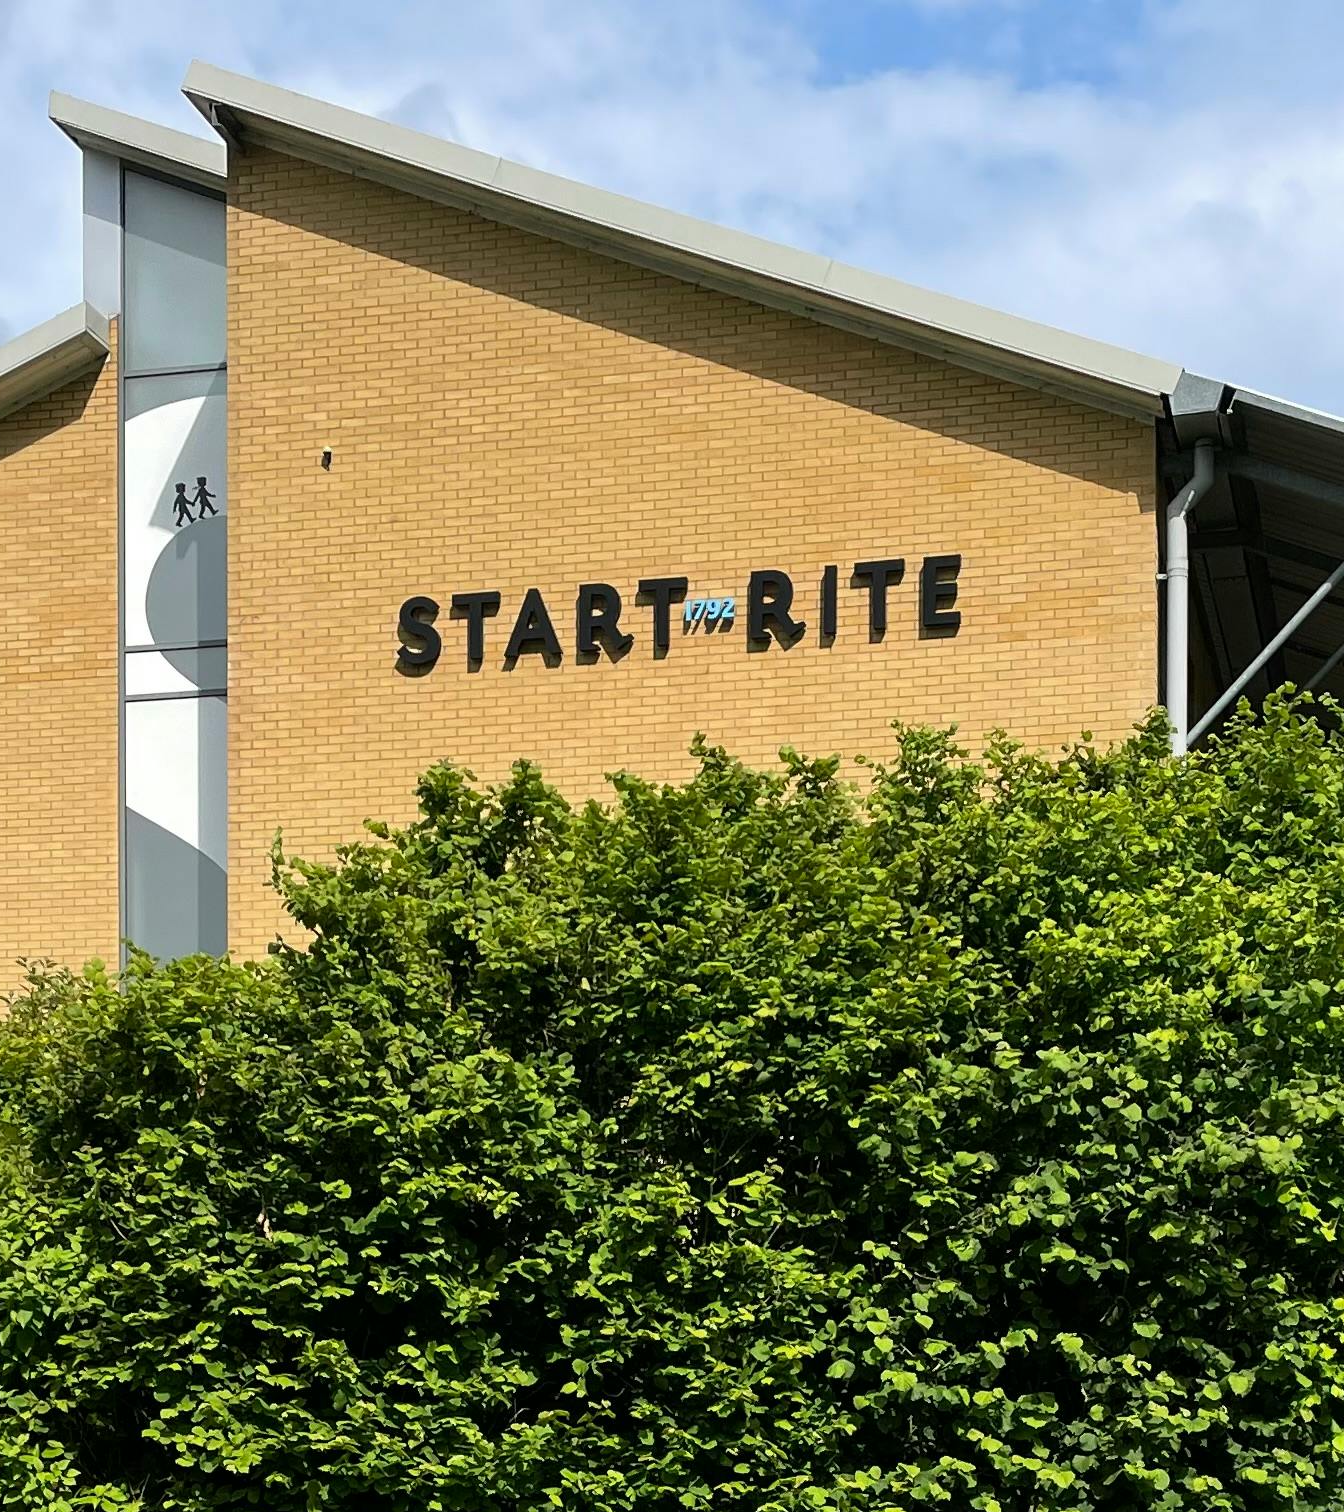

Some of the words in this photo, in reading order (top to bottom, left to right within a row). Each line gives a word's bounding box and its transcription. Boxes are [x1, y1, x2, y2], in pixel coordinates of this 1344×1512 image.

[397, 576, 689, 667] START
[684, 597, 736, 622] 1792
[748, 553, 962, 646] RITE
